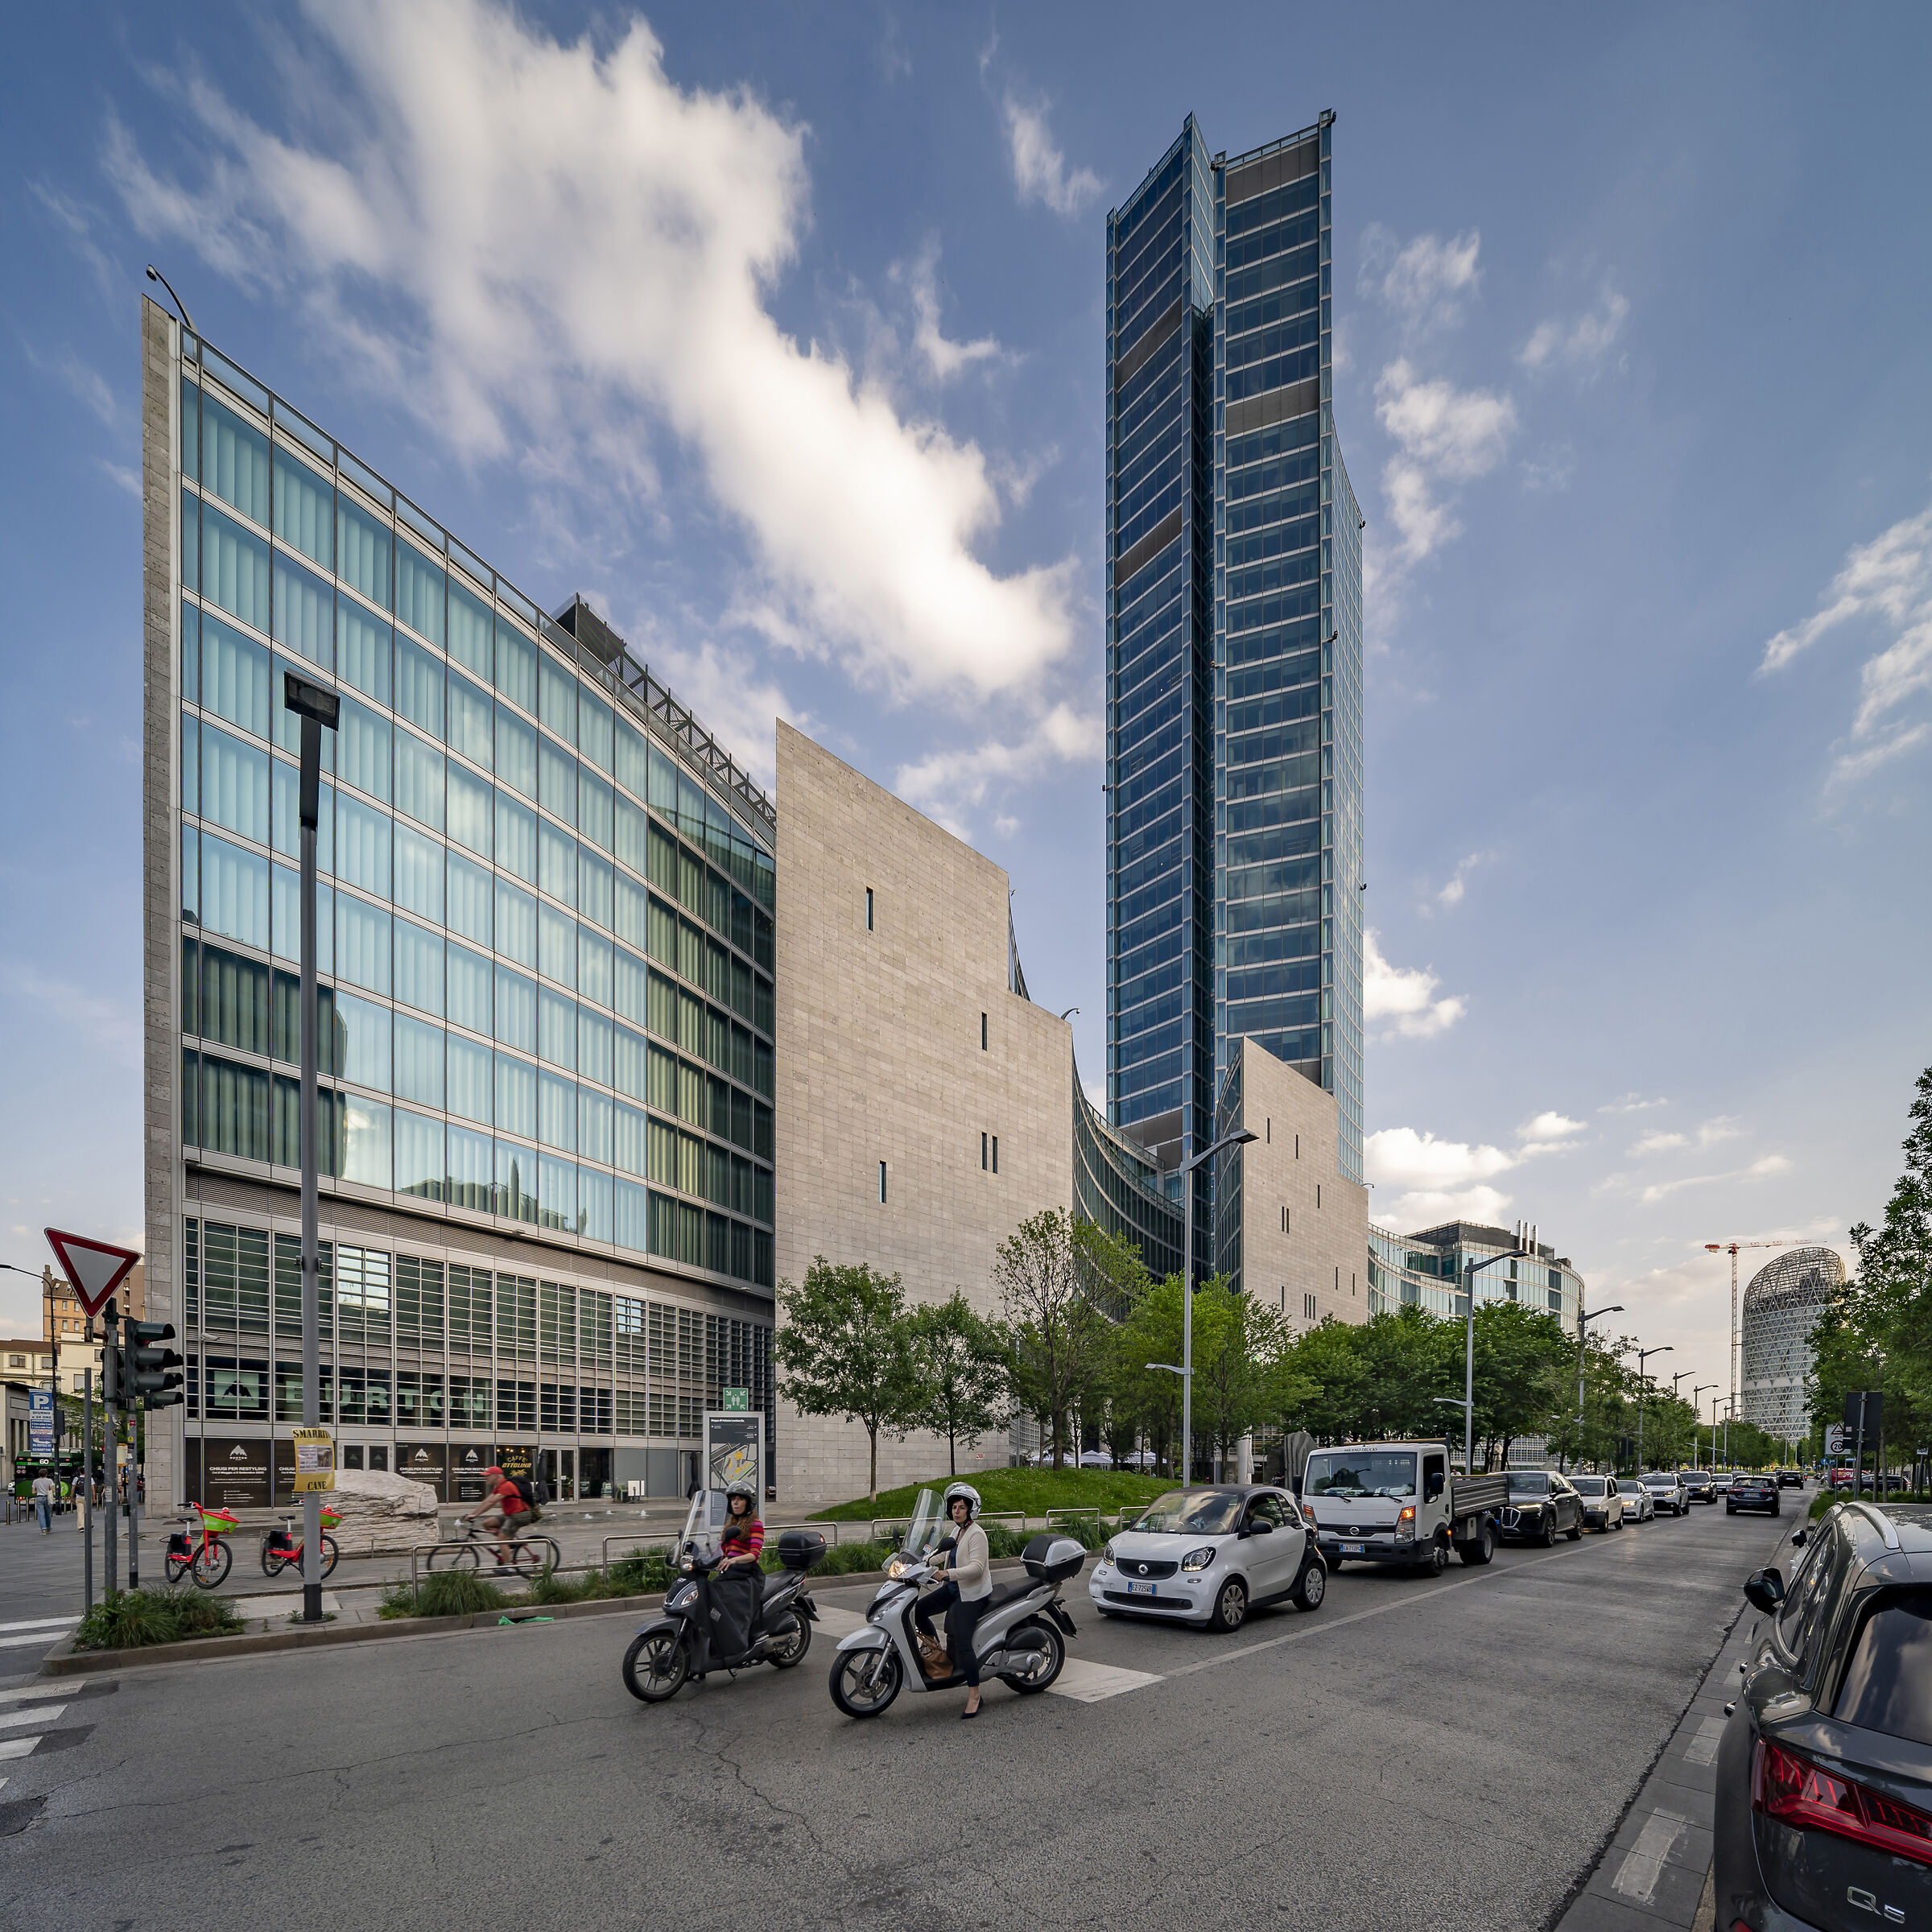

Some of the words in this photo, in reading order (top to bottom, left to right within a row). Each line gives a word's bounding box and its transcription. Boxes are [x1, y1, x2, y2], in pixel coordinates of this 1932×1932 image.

[33, 1394, 50, 1410] P
[285, 1380, 484, 1414] BURTON
[292, 1429, 331, 1439] SMARRIT
[307, 1480, 327, 1491] CANE
[1847, 1885, 1905, 1924] Q5
